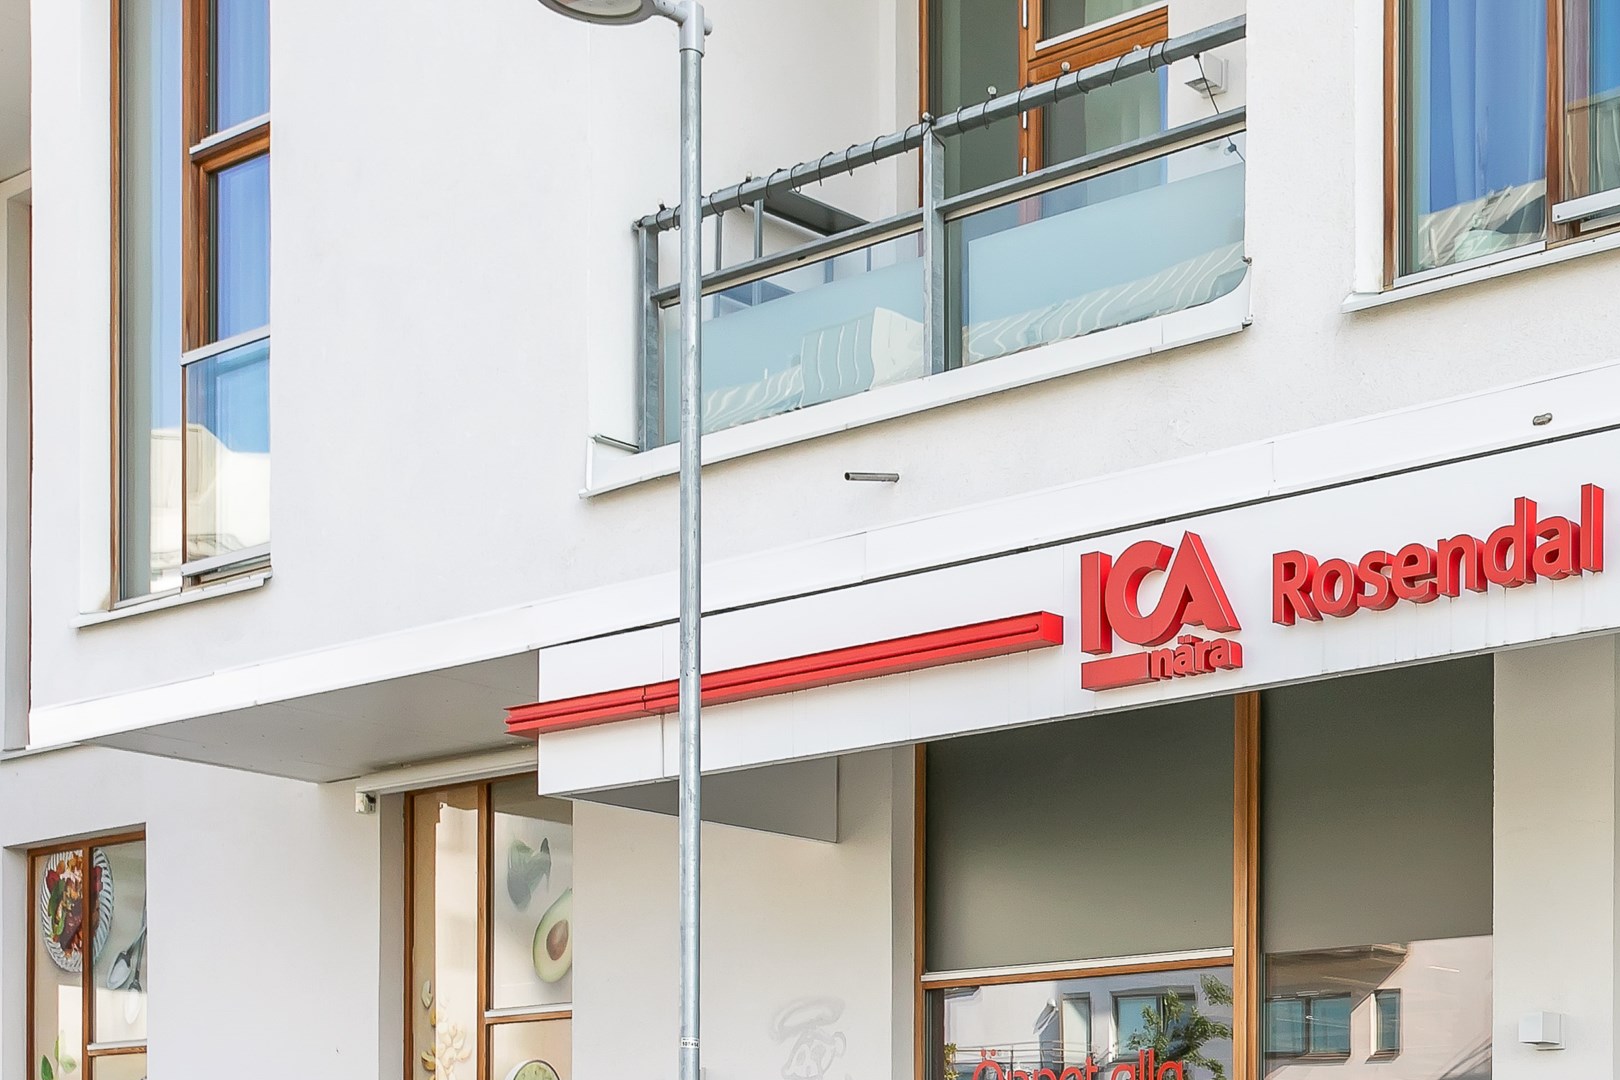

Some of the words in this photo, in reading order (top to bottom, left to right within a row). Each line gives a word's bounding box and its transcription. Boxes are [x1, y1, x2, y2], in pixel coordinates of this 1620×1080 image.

[1080, 530, 1241, 654] ICA
[1272, 483, 1604, 627] Rosendal
[1151, 635, 1243, 682] nära
